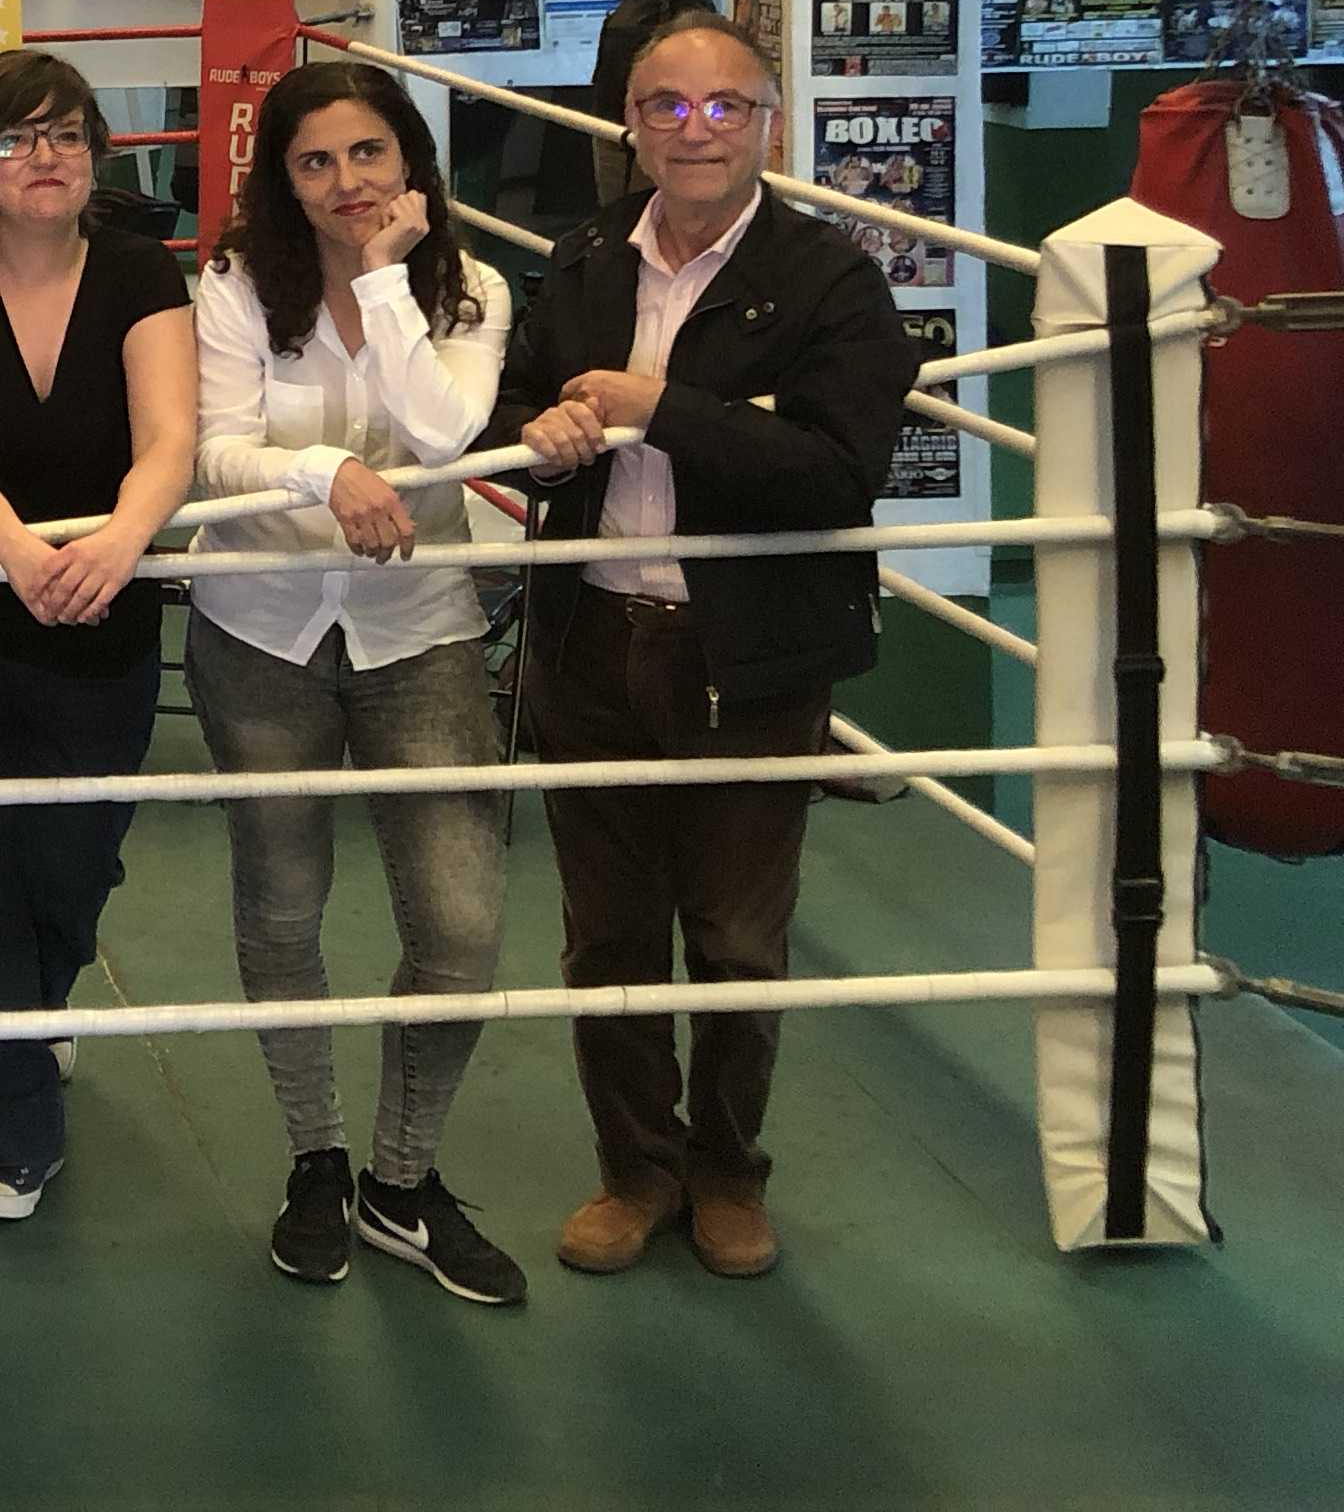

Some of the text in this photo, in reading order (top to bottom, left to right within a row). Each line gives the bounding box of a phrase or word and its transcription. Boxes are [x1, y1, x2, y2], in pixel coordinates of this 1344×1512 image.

[1021, 53, 1078, 65] RUDE
[209, 69, 281, 85] RUDE BOYS
